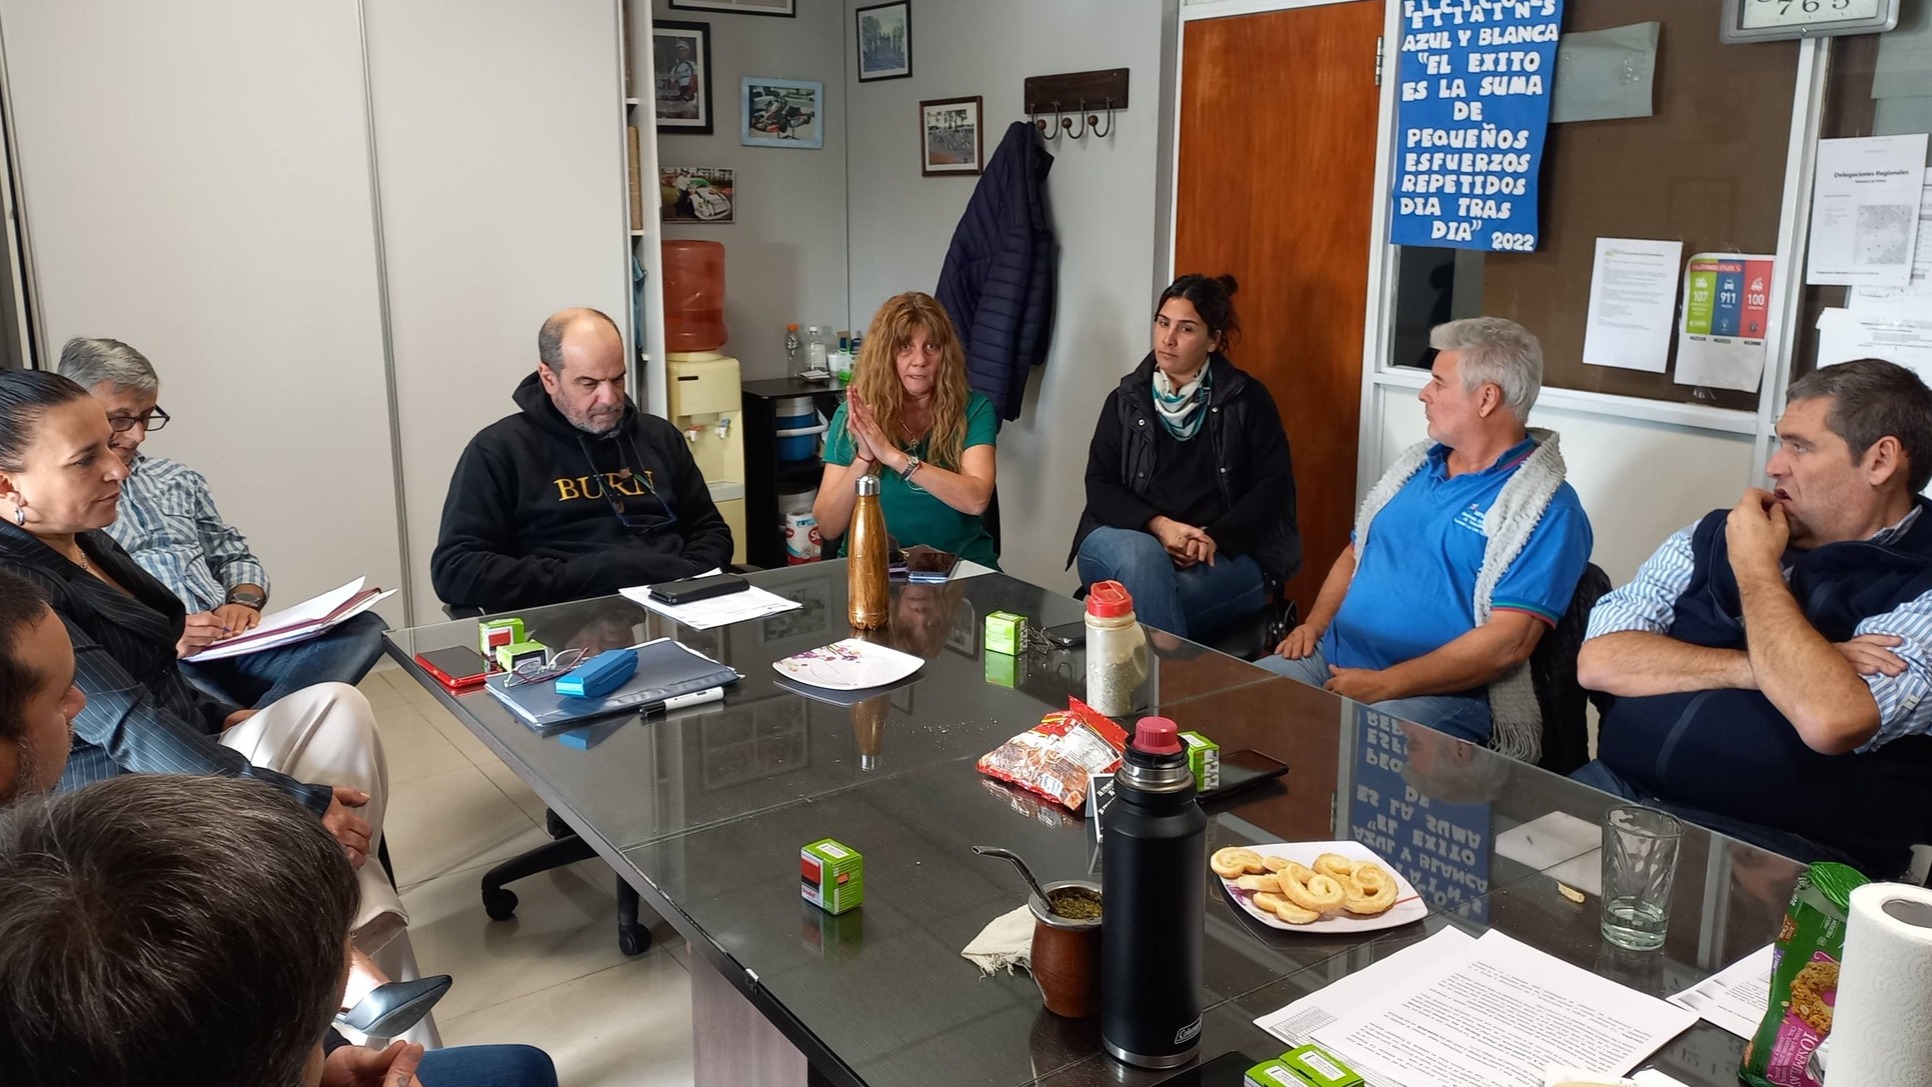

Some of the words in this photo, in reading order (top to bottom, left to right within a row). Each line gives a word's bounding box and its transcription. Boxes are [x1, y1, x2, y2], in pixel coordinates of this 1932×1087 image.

[1401, 31, 1452, 52] AZUL
[1457, 29, 1472, 47] Y
[1478, 23, 1559, 46] BLANCA
[1468, 51, 1541, 73] EXITO
[1402, 80, 1428, 102] ES
[1439, 78, 1466, 98] LA
[1479, 74, 1543, 96] SUMA
[1453, 101, 1483, 121] DE
[1407, 122, 1529, 150] PEQUEÑOS
[1405, 152, 1531, 173] ESFUERZOS
[1401, 173, 1526, 195] REPETIDOS
[1400, 197, 1442, 216] DIA
[1458, 197, 1511, 219] TRAS
[1491, 231, 1535, 252] 2022
[1721, 292, 1736, 304] 911
[1747, 294, 1765, 306] 100
